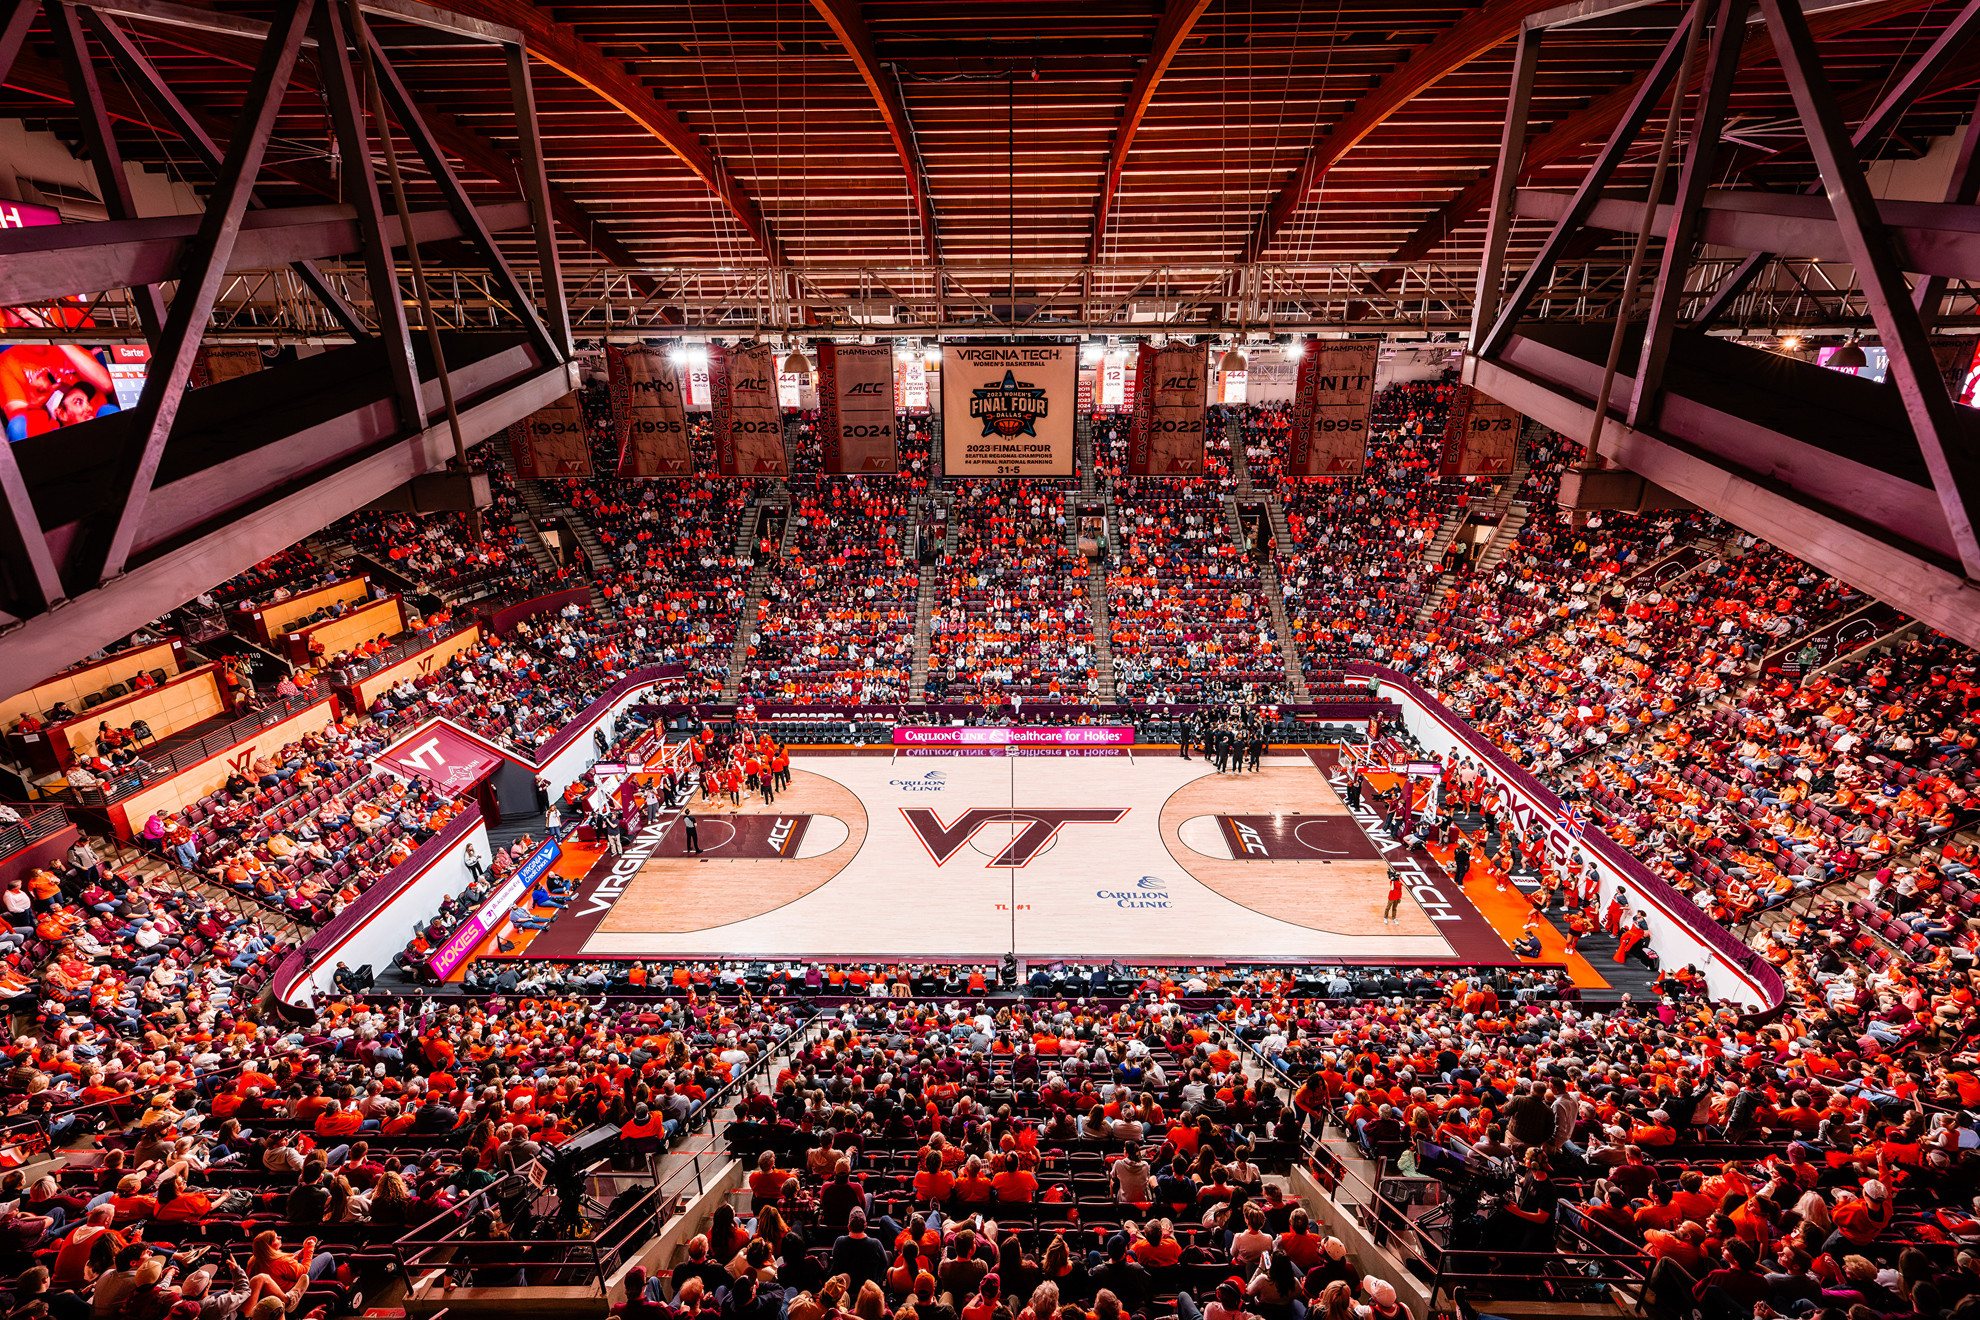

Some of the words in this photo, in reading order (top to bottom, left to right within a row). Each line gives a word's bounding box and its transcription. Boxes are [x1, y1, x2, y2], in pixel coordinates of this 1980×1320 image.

[120, 348, 144, 357] Carter
[204, 350, 258, 358] CHAMPIONS
[837, 348, 889, 356] CHAMPIONS
[1320, 344, 1376, 352] CHAMPIONS
[957, 349, 1019, 360] VIRGINIA
[1021, 349, 1061, 360] TECH
[692, 373, 709, 382] 33
[1106, 371, 1121, 380] 12
[634, 377, 674, 393] metro
[735, 379, 767, 390] ACC
[848, 383, 885, 393] ACC
[1161, 377, 1199, 389] ACC
[1320, 376, 1370, 391] NIT
[717, 356, 733, 464] BASKETBALL
[820, 371, 831, 448] WOMEN'S
[826, 362, 839, 458] BASKETBALL
[971, 398, 1008, 415] FINAL
[1011, 398, 1046, 414] FOUR
[1136, 356, 1152, 464] BASKETBALL
[1297, 352, 1318, 464] BASKETBALL
[530, 422, 579, 435] 1994
[633, 421, 682, 433] 1995
[732, 422, 779, 434] 2023
[842, 425, 891, 437] 2024
[1152, 421, 1201, 433] 2022
[1315, 419, 1363, 432] 1995
[1471, 418, 1512, 432] 1973
[565, 460, 583, 471] VT
[666, 460, 685, 471] VT
[763, 460, 781, 470] VT
[872, 459, 891, 468] VT
[1178, 459, 1197, 470] VT
[1338, 458, 1357, 469] VT
[1489, 458, 1507, 469] VT
[417, 654, 434, 673] VT
[905, 731, 951, 742] CARILION
[951, 731, 987, 741] CLINIC
[1006, 730, 1063, 741] Healthcare
[1064, 730, 1081, 741] for
[1084, 730, 1122, 741] Hokies
[227, 746, 256, 773] VT
[398, 736, 446, 771] VT
[463, 759, 480, 772] MAIN
[889, 779, 946, 787] CARILION
[766, 817, 794, 853] ACC
[898, 807, 1132, 868] VT
[1234, 820, 1269, 857] ACC
[520, 854, 543, 877] VIRGINIA
[575, 820, 673, 918] VIRGINIA
[1097, 890, 1169, 899] CARILION
[1390, 856, 1462, 921] TECH
[1117, 899, 1173, 908] CLINIC
